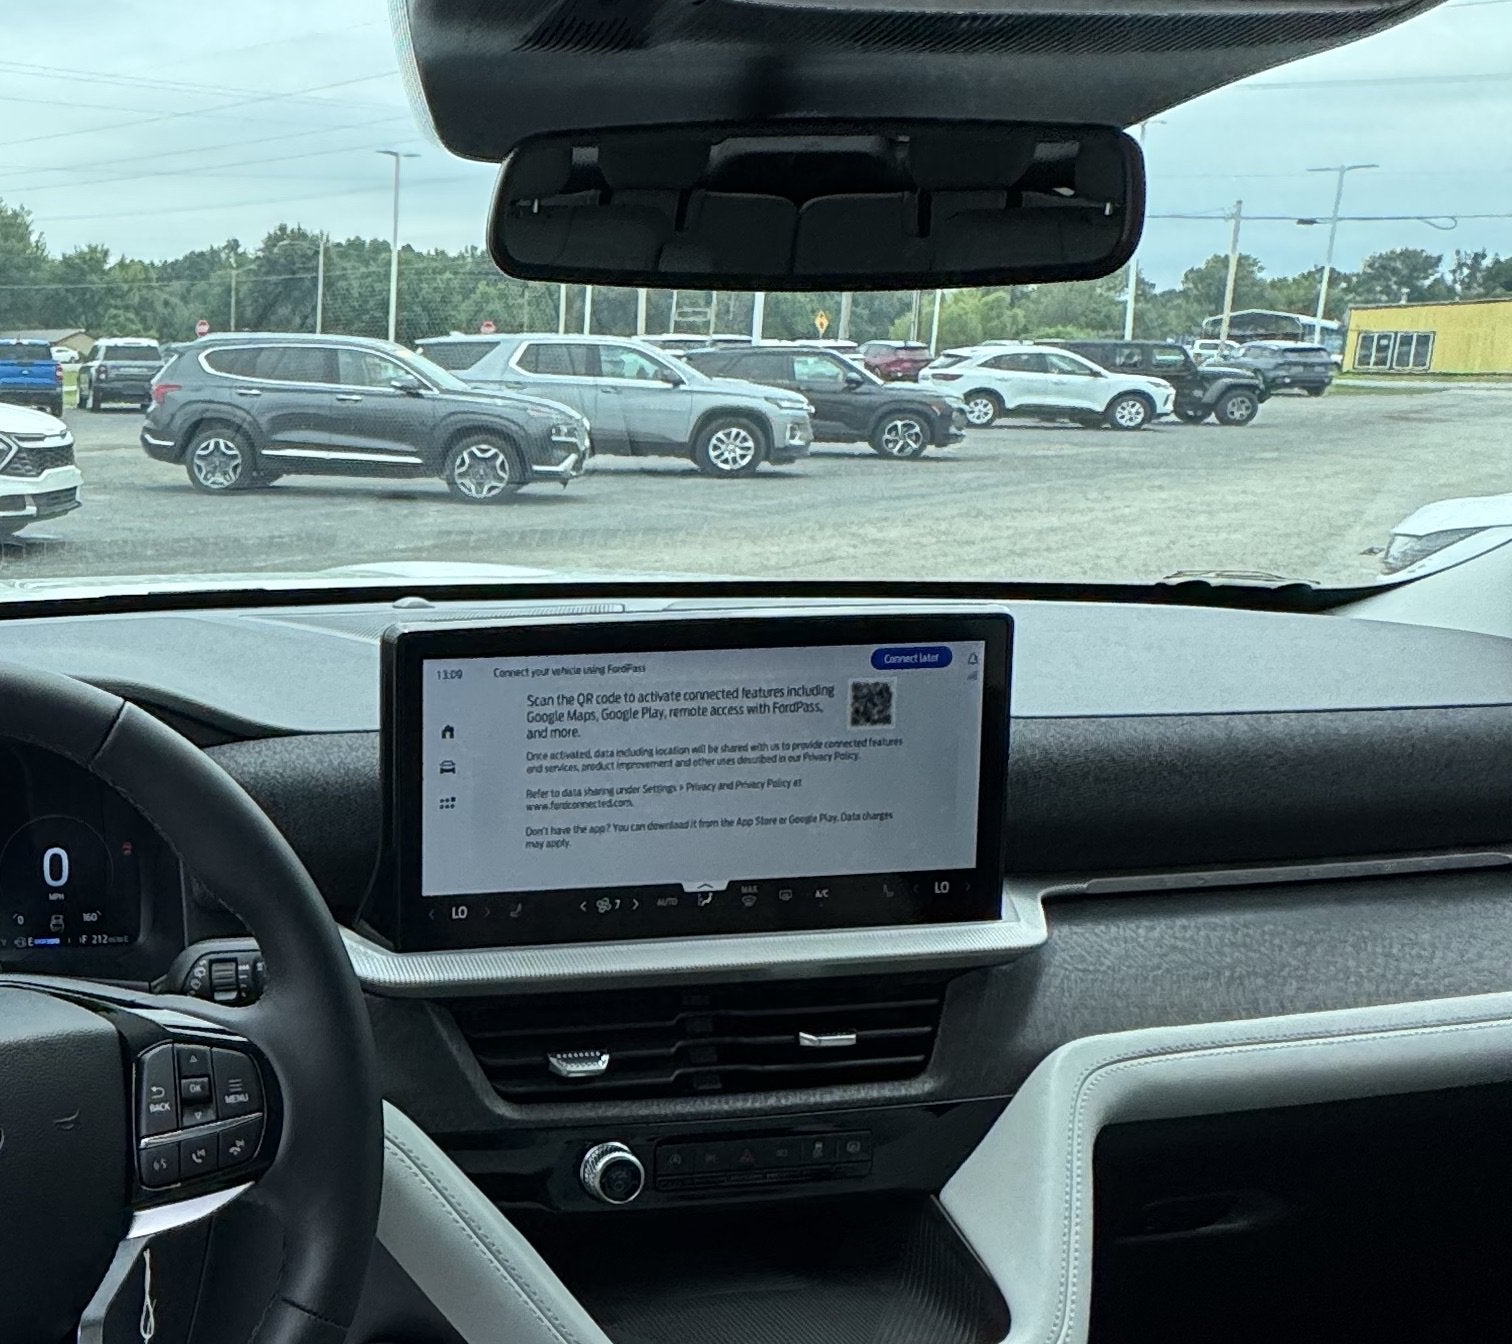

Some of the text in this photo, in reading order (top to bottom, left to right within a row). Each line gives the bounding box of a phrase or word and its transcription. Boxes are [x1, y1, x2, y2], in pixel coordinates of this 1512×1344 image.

[884, 654, 918, 664] Connect
[493, 667, 529, 678] Connect
[552, 666, 581, 676] vehicle
[607, 664, 646, 674] FordPass
[527, 684, 835, 707] Scan the QR code to activate connected features including
[527, 710, 565, 725] Google
[567, 709, 599, 723] Maps,
[601, 707, 639, 722] Google
[641, 706, 668, 721] Play,
[669, 705, 707, 718] remote
[709, 705, 744, 716] access
[747, 702, 770, 714] with
[527, 727, 581, 739] and more.
[594, 748, 614, 758] data
[550, 788, 560, 798] to
[561, 787, 582, 797] data
[43, 846, 69, 887] 0
[934, 882, 950, 894] LO
[48, 893, 65, 901] MPH
[614, 899, 621, 909] 7
[451, 906, 468, 920] LO
[91, 934, 109, 944] 212
[189, 1084, 201, 1093] OK
[224, 1093, 249, 1104] MENU
[149, 1102, 171, 1113] BACK
